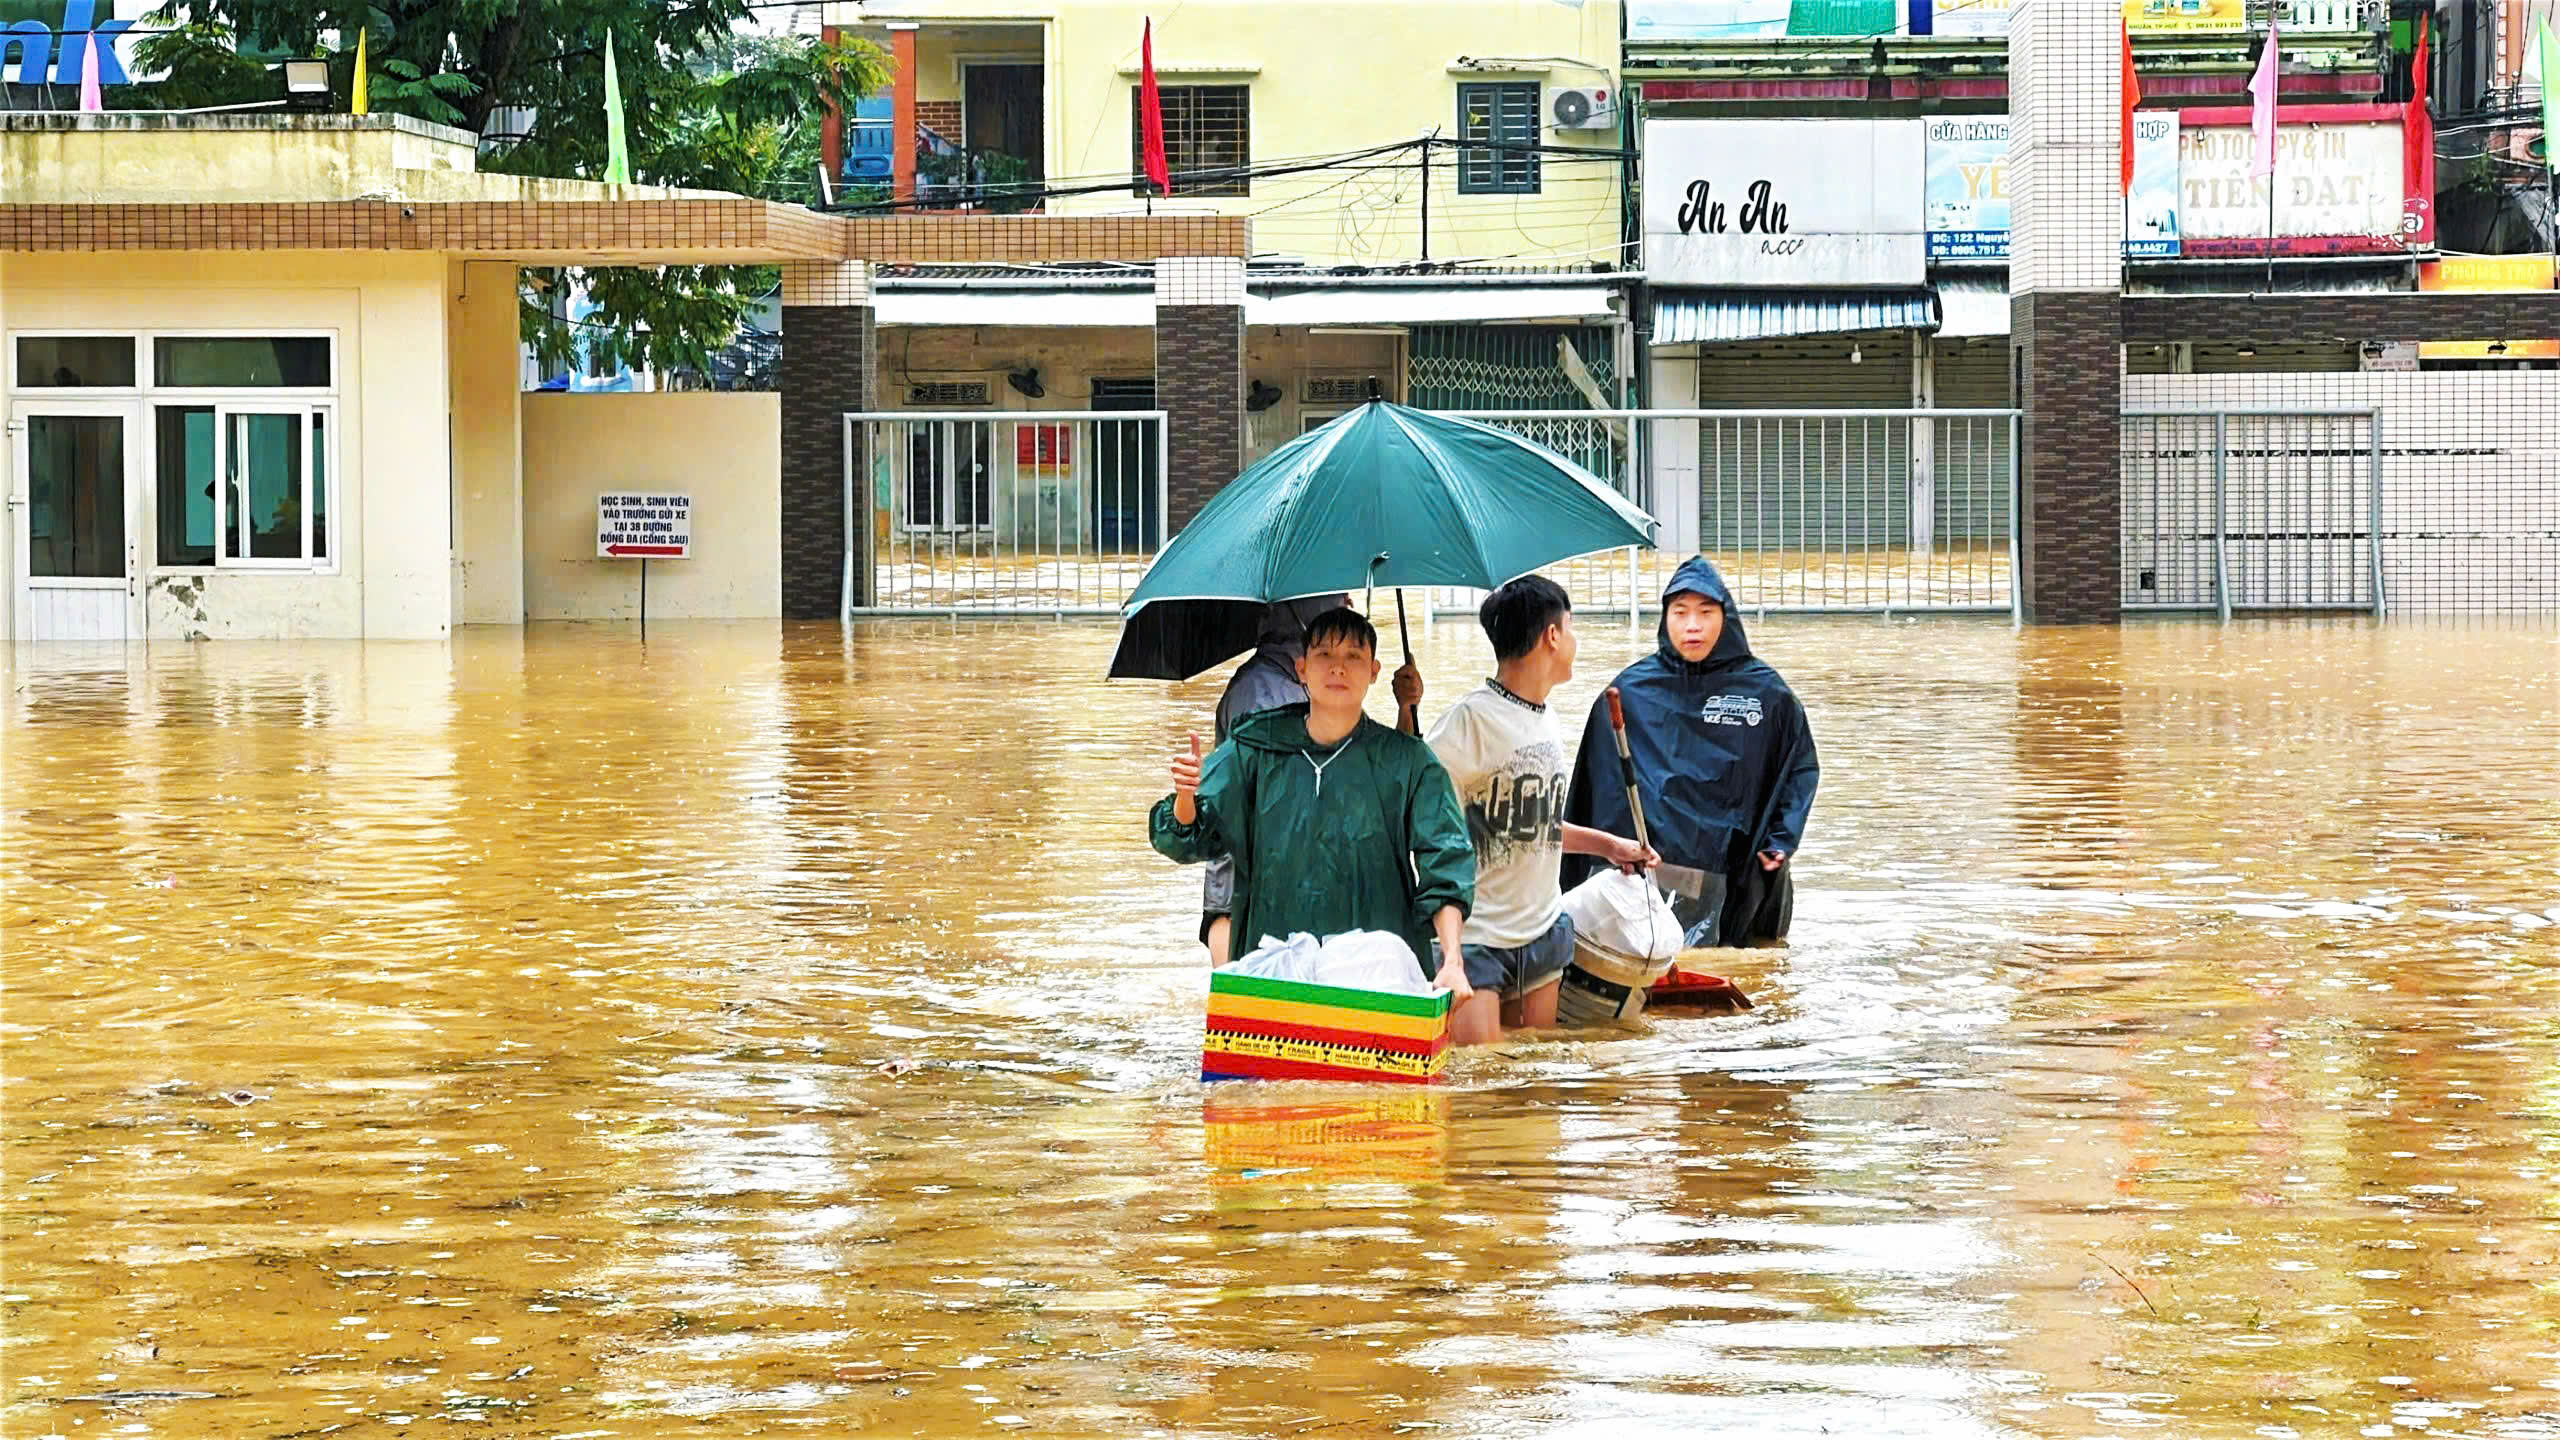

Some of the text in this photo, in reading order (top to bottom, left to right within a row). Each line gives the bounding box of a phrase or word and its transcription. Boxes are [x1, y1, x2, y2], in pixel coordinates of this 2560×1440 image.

[1930, 120, 2009, 141] CỬA HÀNG
[2136, 120, 2169, 141] HỢP
[1678, 179, 1789, 235] An An
[1954, 233, 1974, 243] 122
[601, 496, 689, 507] HỌC SINH, SINH VIÊN
[603, 508, 620, 519] VÀO
[623, 507, 656, 519] TRƯỜNG
[676, 510, 686, 519] XE
[614, 522, 627, 533] TẠI
[643, 520, 672, 532] ĐƯỜNG
[600, 531, 624, 543] ĐỐNG
[626, 534, 638, 543] ĐA
[669, 535, 688, 545] SAU)
